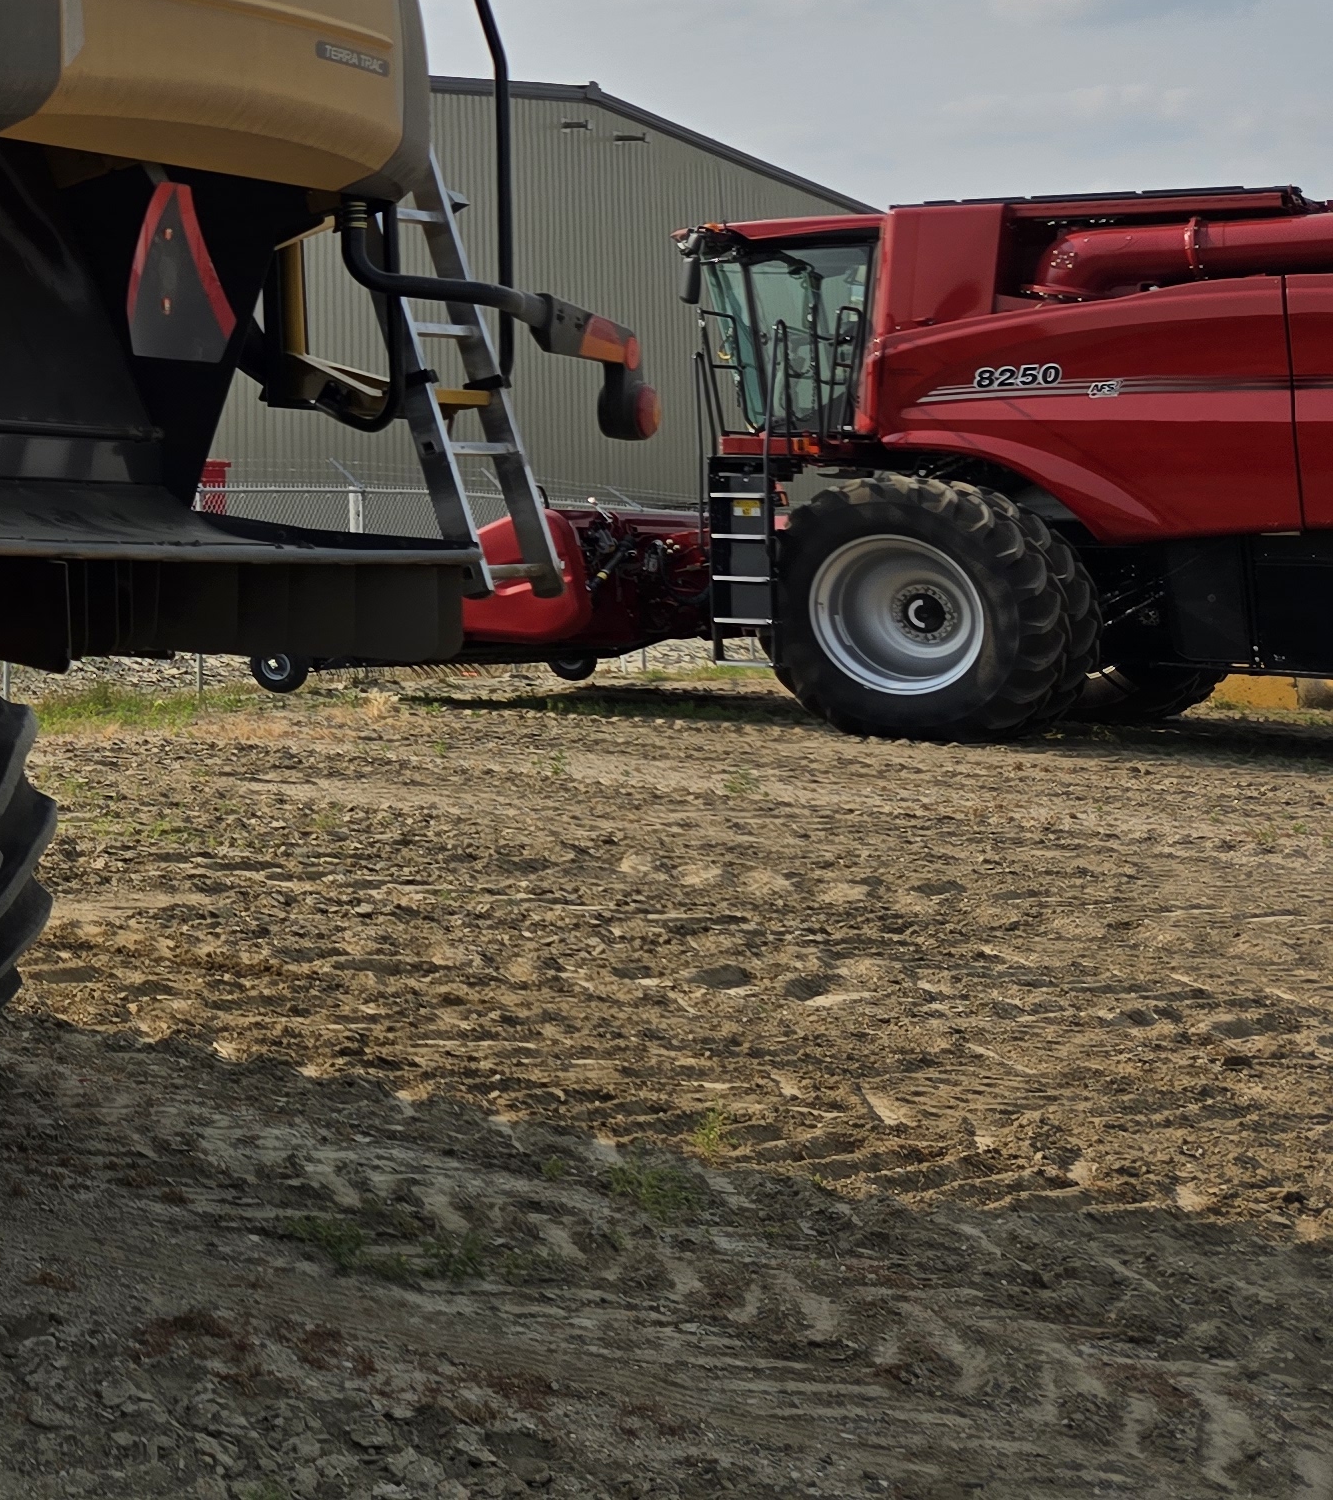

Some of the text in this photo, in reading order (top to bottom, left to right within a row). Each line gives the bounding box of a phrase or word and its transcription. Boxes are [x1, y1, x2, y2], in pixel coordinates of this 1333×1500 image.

[324, 44, 384, 73] TERRA TRAC
[974, 363, 1062, 389] 8250
[1090, 383, 1116, 393] AFS
